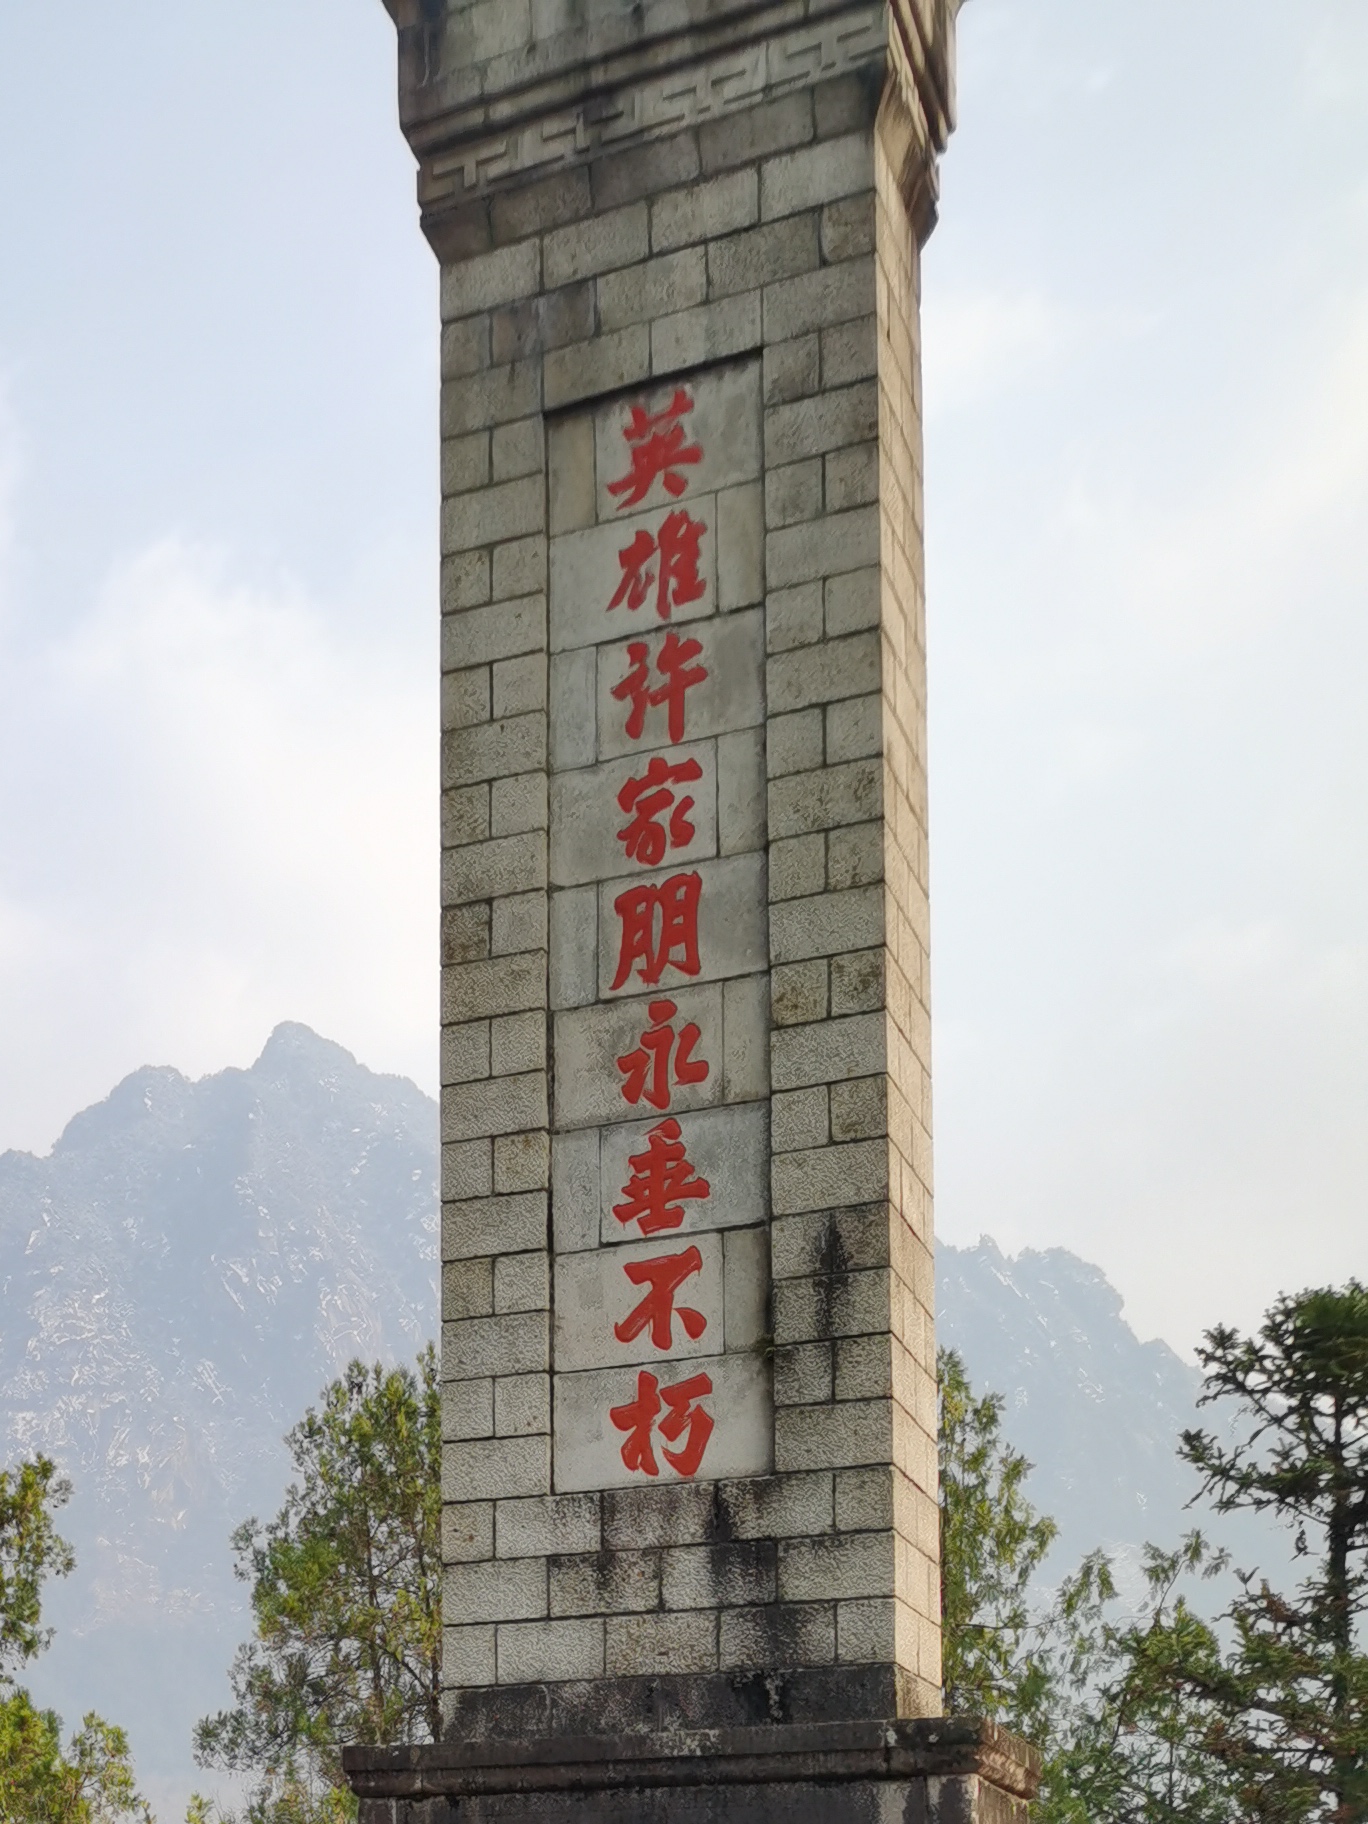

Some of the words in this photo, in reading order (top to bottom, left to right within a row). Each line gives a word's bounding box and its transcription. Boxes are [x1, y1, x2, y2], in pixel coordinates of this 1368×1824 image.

[608, 390, 712, 1476] 英雄许家朋永垂不朽
